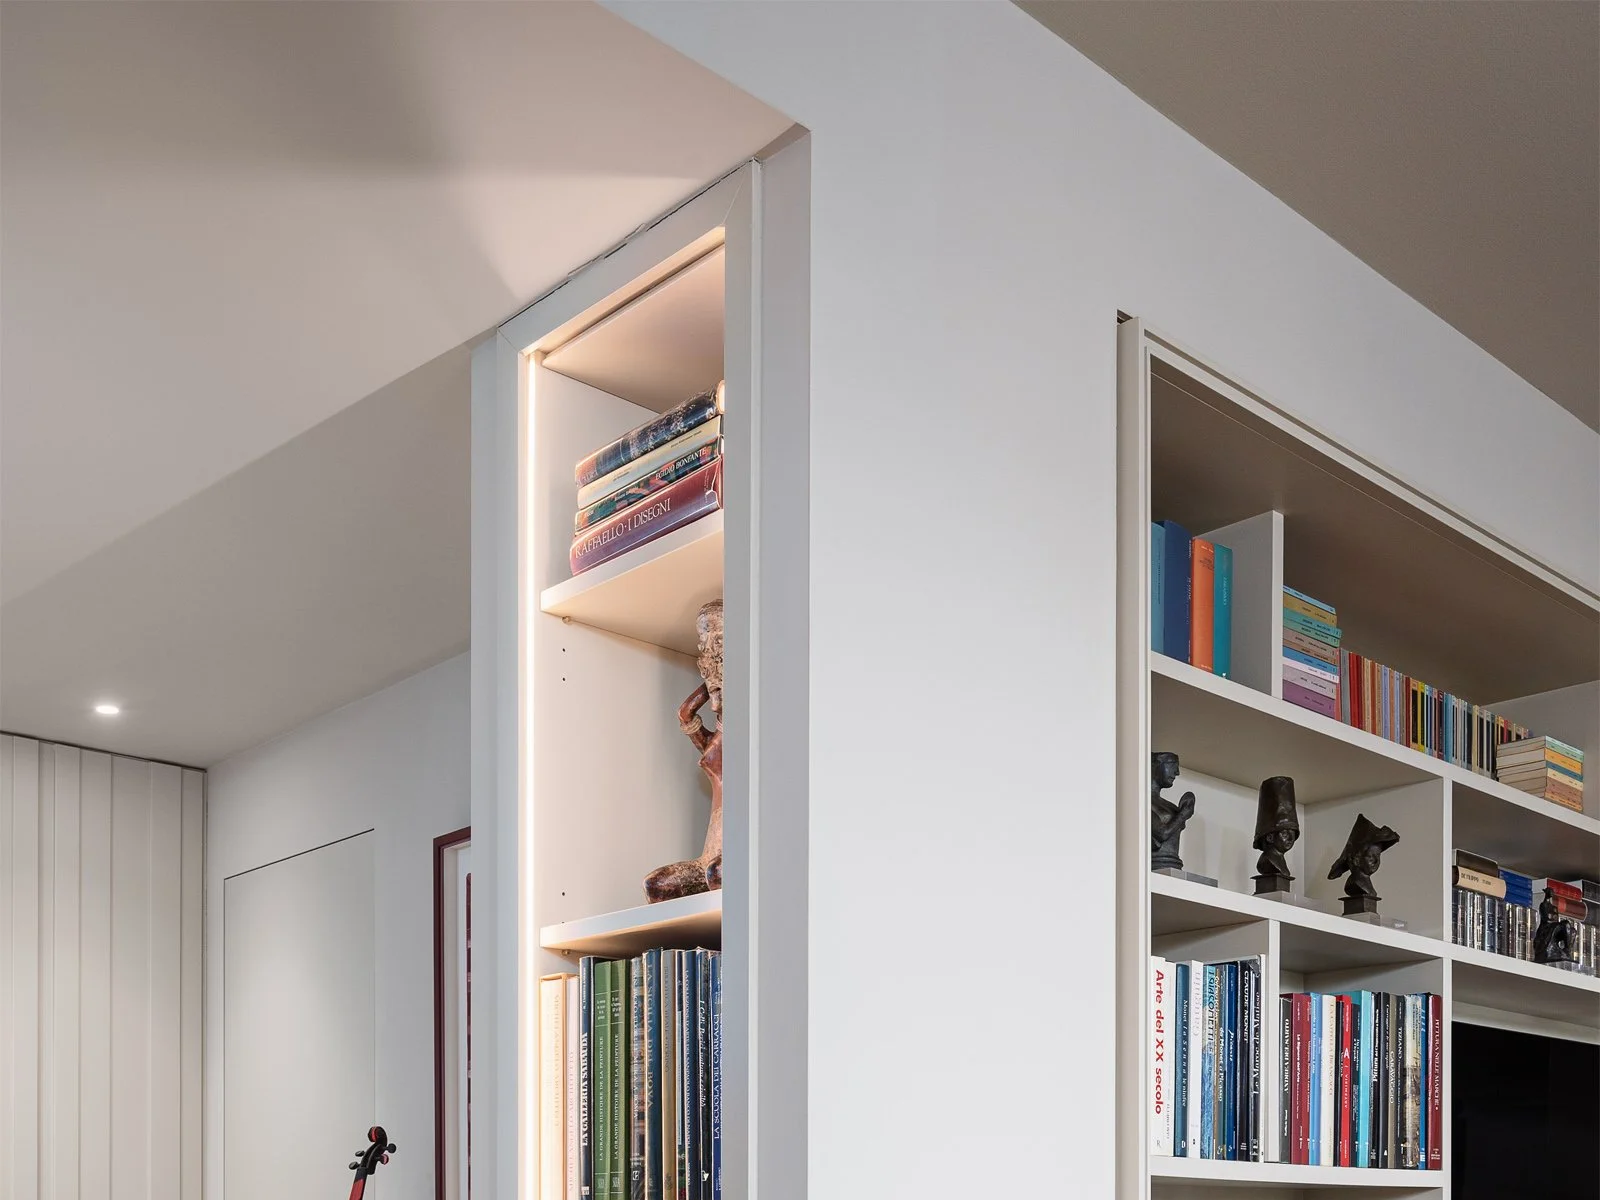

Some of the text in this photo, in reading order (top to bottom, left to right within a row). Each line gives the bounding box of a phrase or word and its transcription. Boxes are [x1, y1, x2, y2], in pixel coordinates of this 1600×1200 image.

[675, 447, 708, 471] BONFANTE
[574, 498, 672, 558] RAFFAELLO I DISEGNI
[647, 964, 654, 981] LA
[1252, 991, 1261, 1028] Matisse
[1155, 969, 1164, 1115] Arte del XX secolo
[1252, 1032, 1261, 1044] de
[1252, 1047, 1261, 1079] Maroc
[598, 1070, 604, 1080] LA
[613, 1068, 619, 1077] LA
[598, 1081, 604, 1091] DE
[613, 1078, 619, 1088] DE
[581, 1131, 588, 1147] LA
[713, 1127, 720, 1140] LA
[598, 1151, 604, 1161] LA
[613, 1151, 619, 1160] LA
